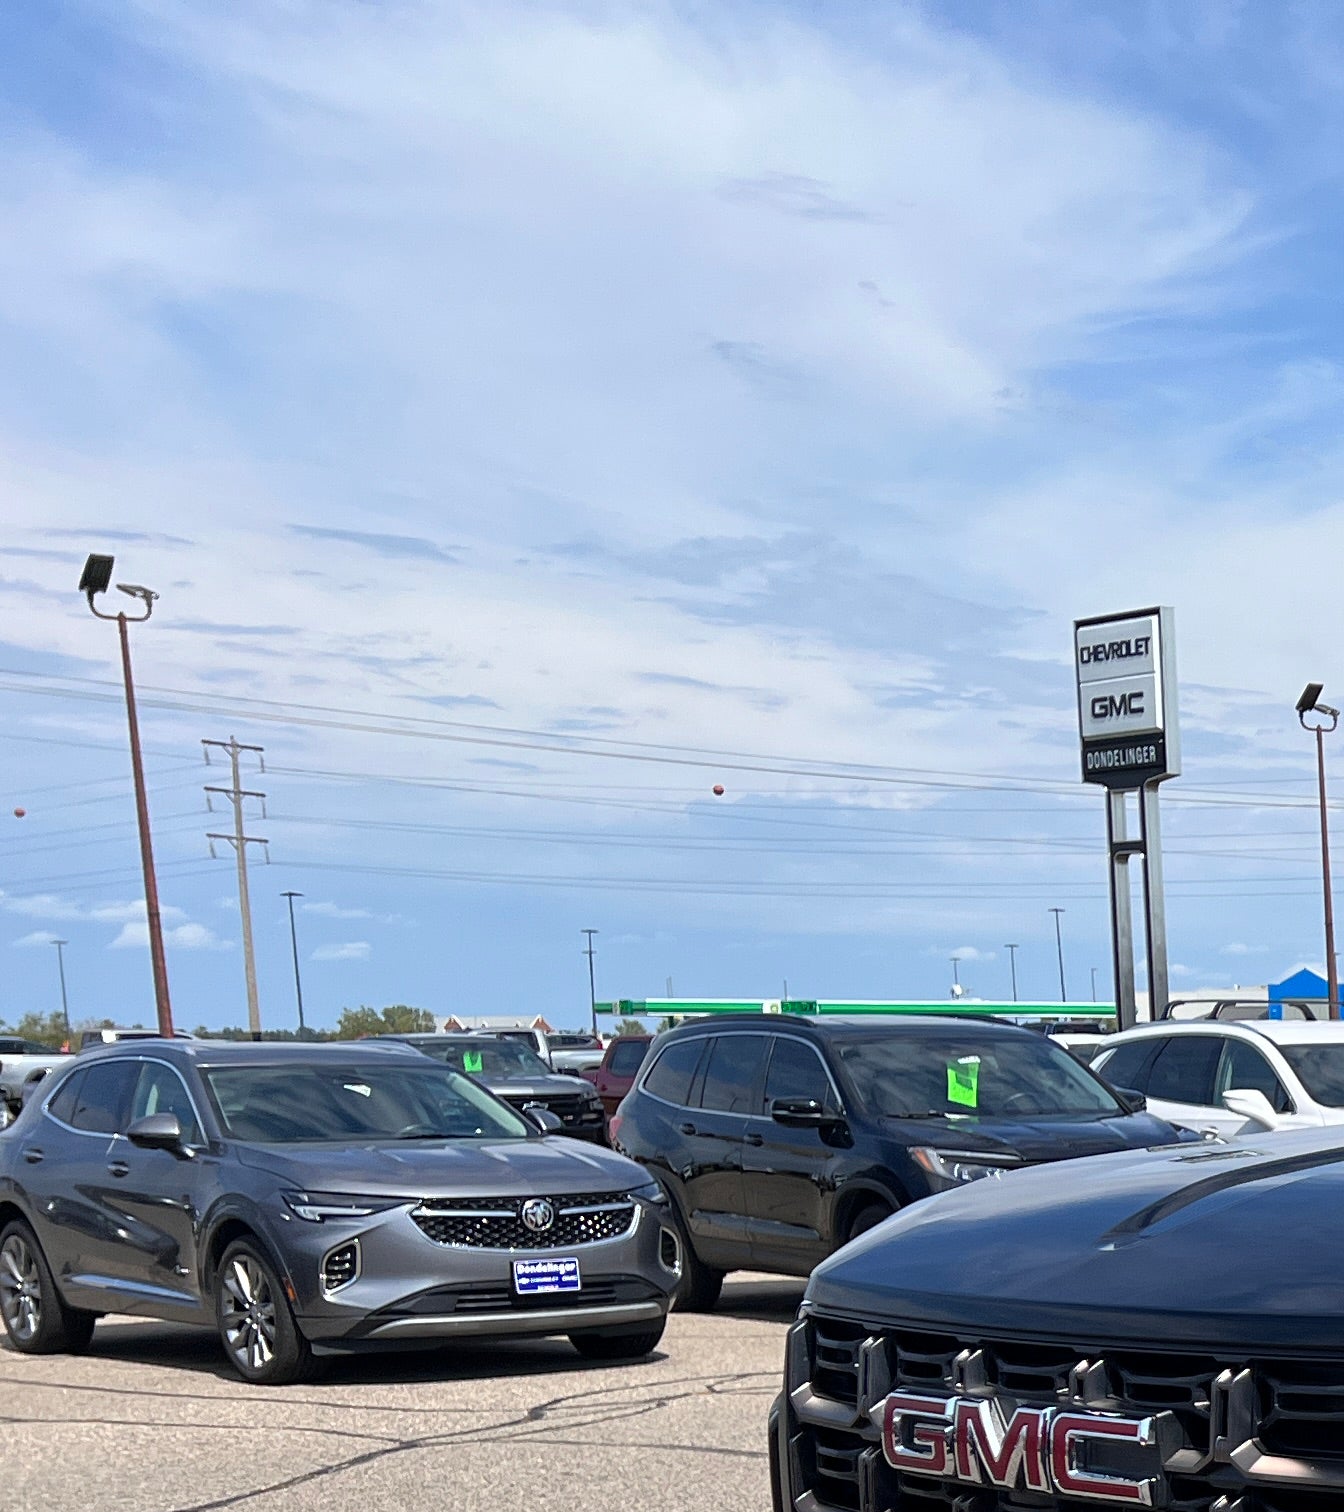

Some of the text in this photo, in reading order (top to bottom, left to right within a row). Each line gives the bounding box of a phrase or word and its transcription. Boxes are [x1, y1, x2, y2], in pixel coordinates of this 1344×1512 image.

[1080, 636, 1150, 665] CHEVROLET
[1091, 691, 1144, 719] GMC
[1087, 746, 1156, 769] DONDELINGER
[882, 1391, 1152, 1505] GMC
